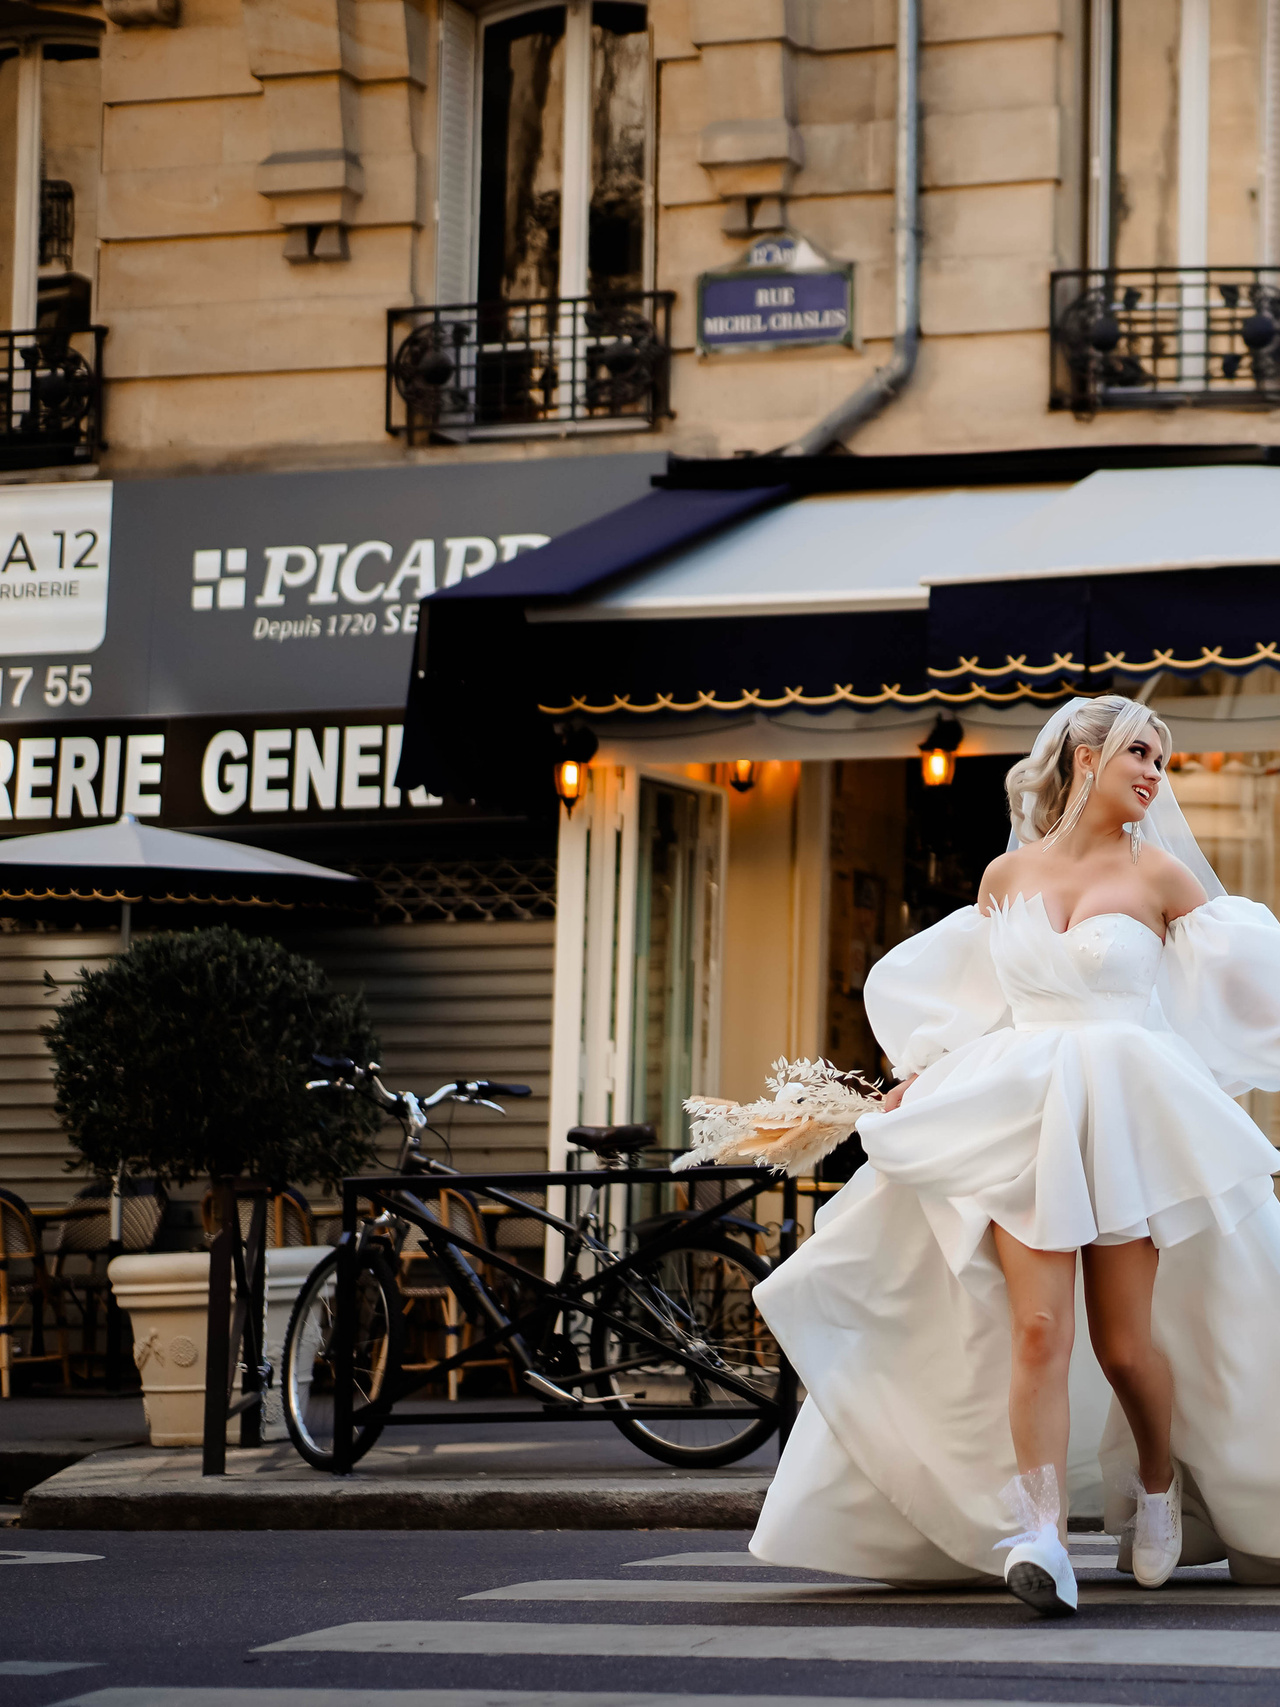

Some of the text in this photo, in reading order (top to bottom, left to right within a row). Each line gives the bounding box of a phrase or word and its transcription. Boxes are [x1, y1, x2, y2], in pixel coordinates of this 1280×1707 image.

[755, 286, 795, 307] RUE
[704, 309, 847, 335] MICHEL CHASLES
[53, 529, 99, 570] 12
[253, 616, 321, 642] Depuis
[326, 612, 377, 636] 1720
[44, 664, 93, 707] 55
